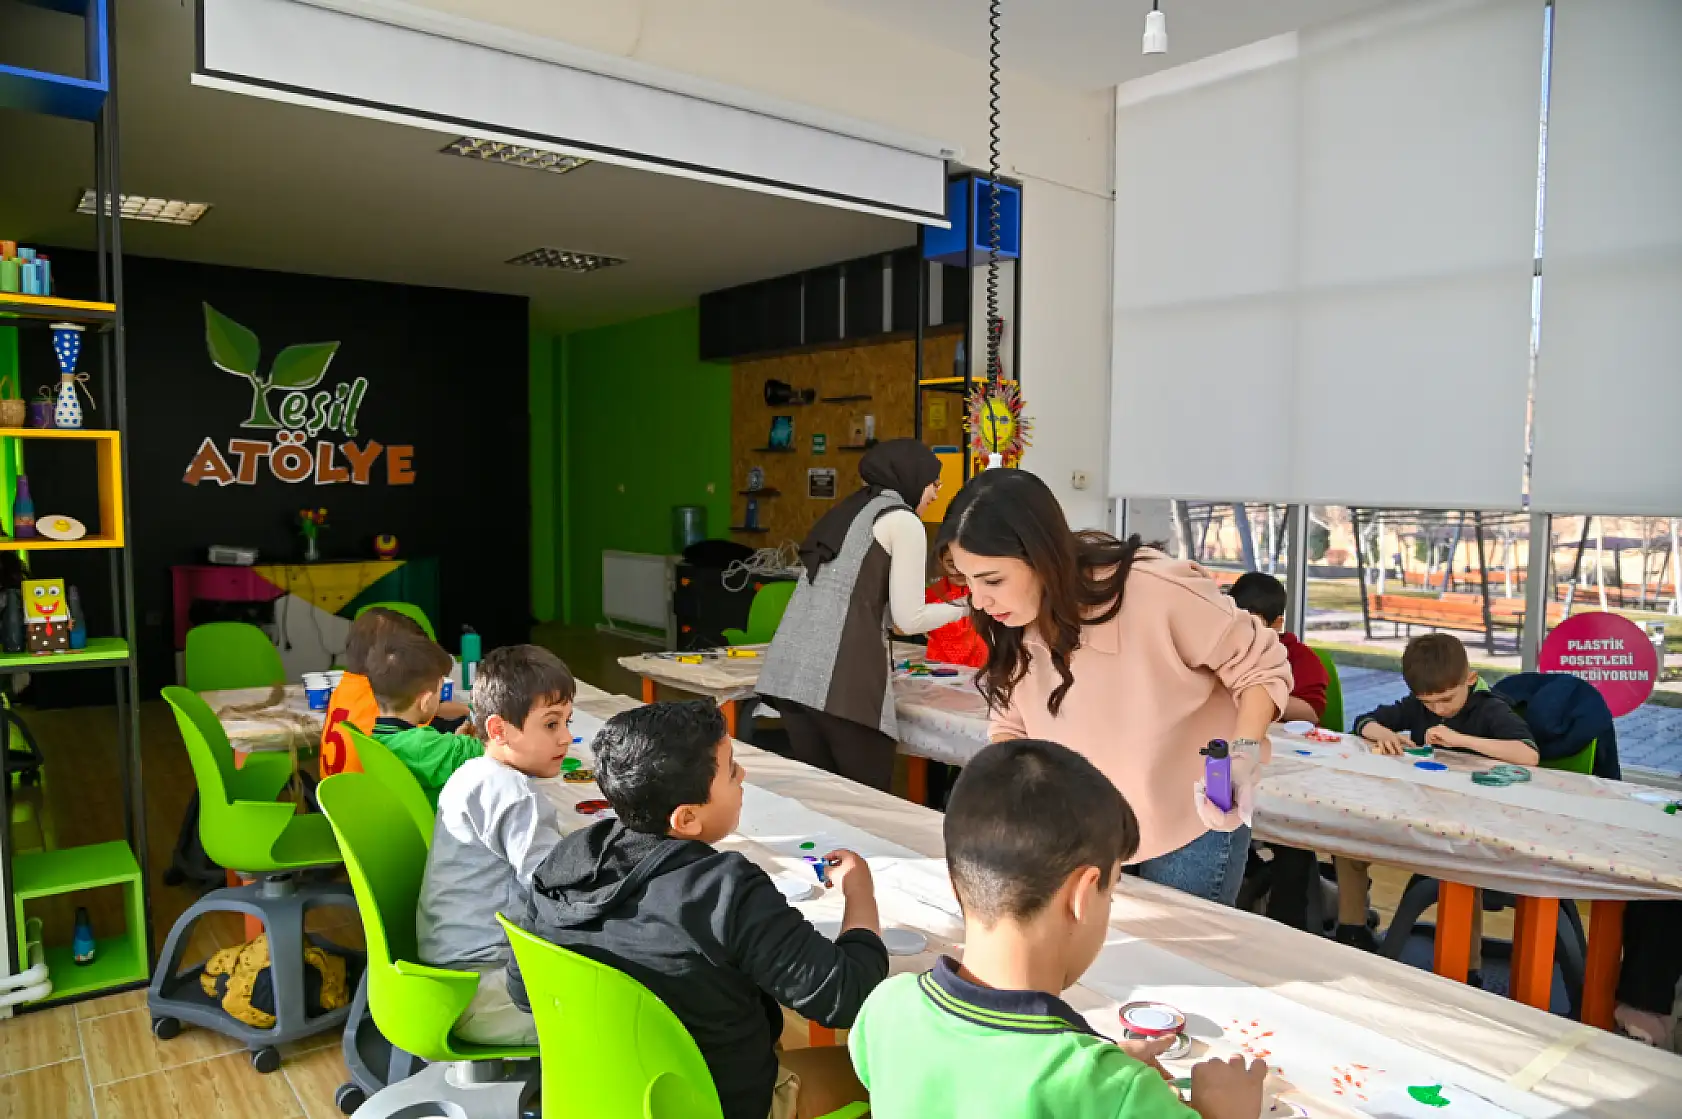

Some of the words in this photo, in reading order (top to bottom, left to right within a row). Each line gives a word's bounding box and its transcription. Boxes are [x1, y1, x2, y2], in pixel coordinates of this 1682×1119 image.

[183, 430, 416, 486] ATÖLYE
[1567, 638, 1624, 650] PLASTİK
[1560, 653, 1633, 666] POŞETLERİ
